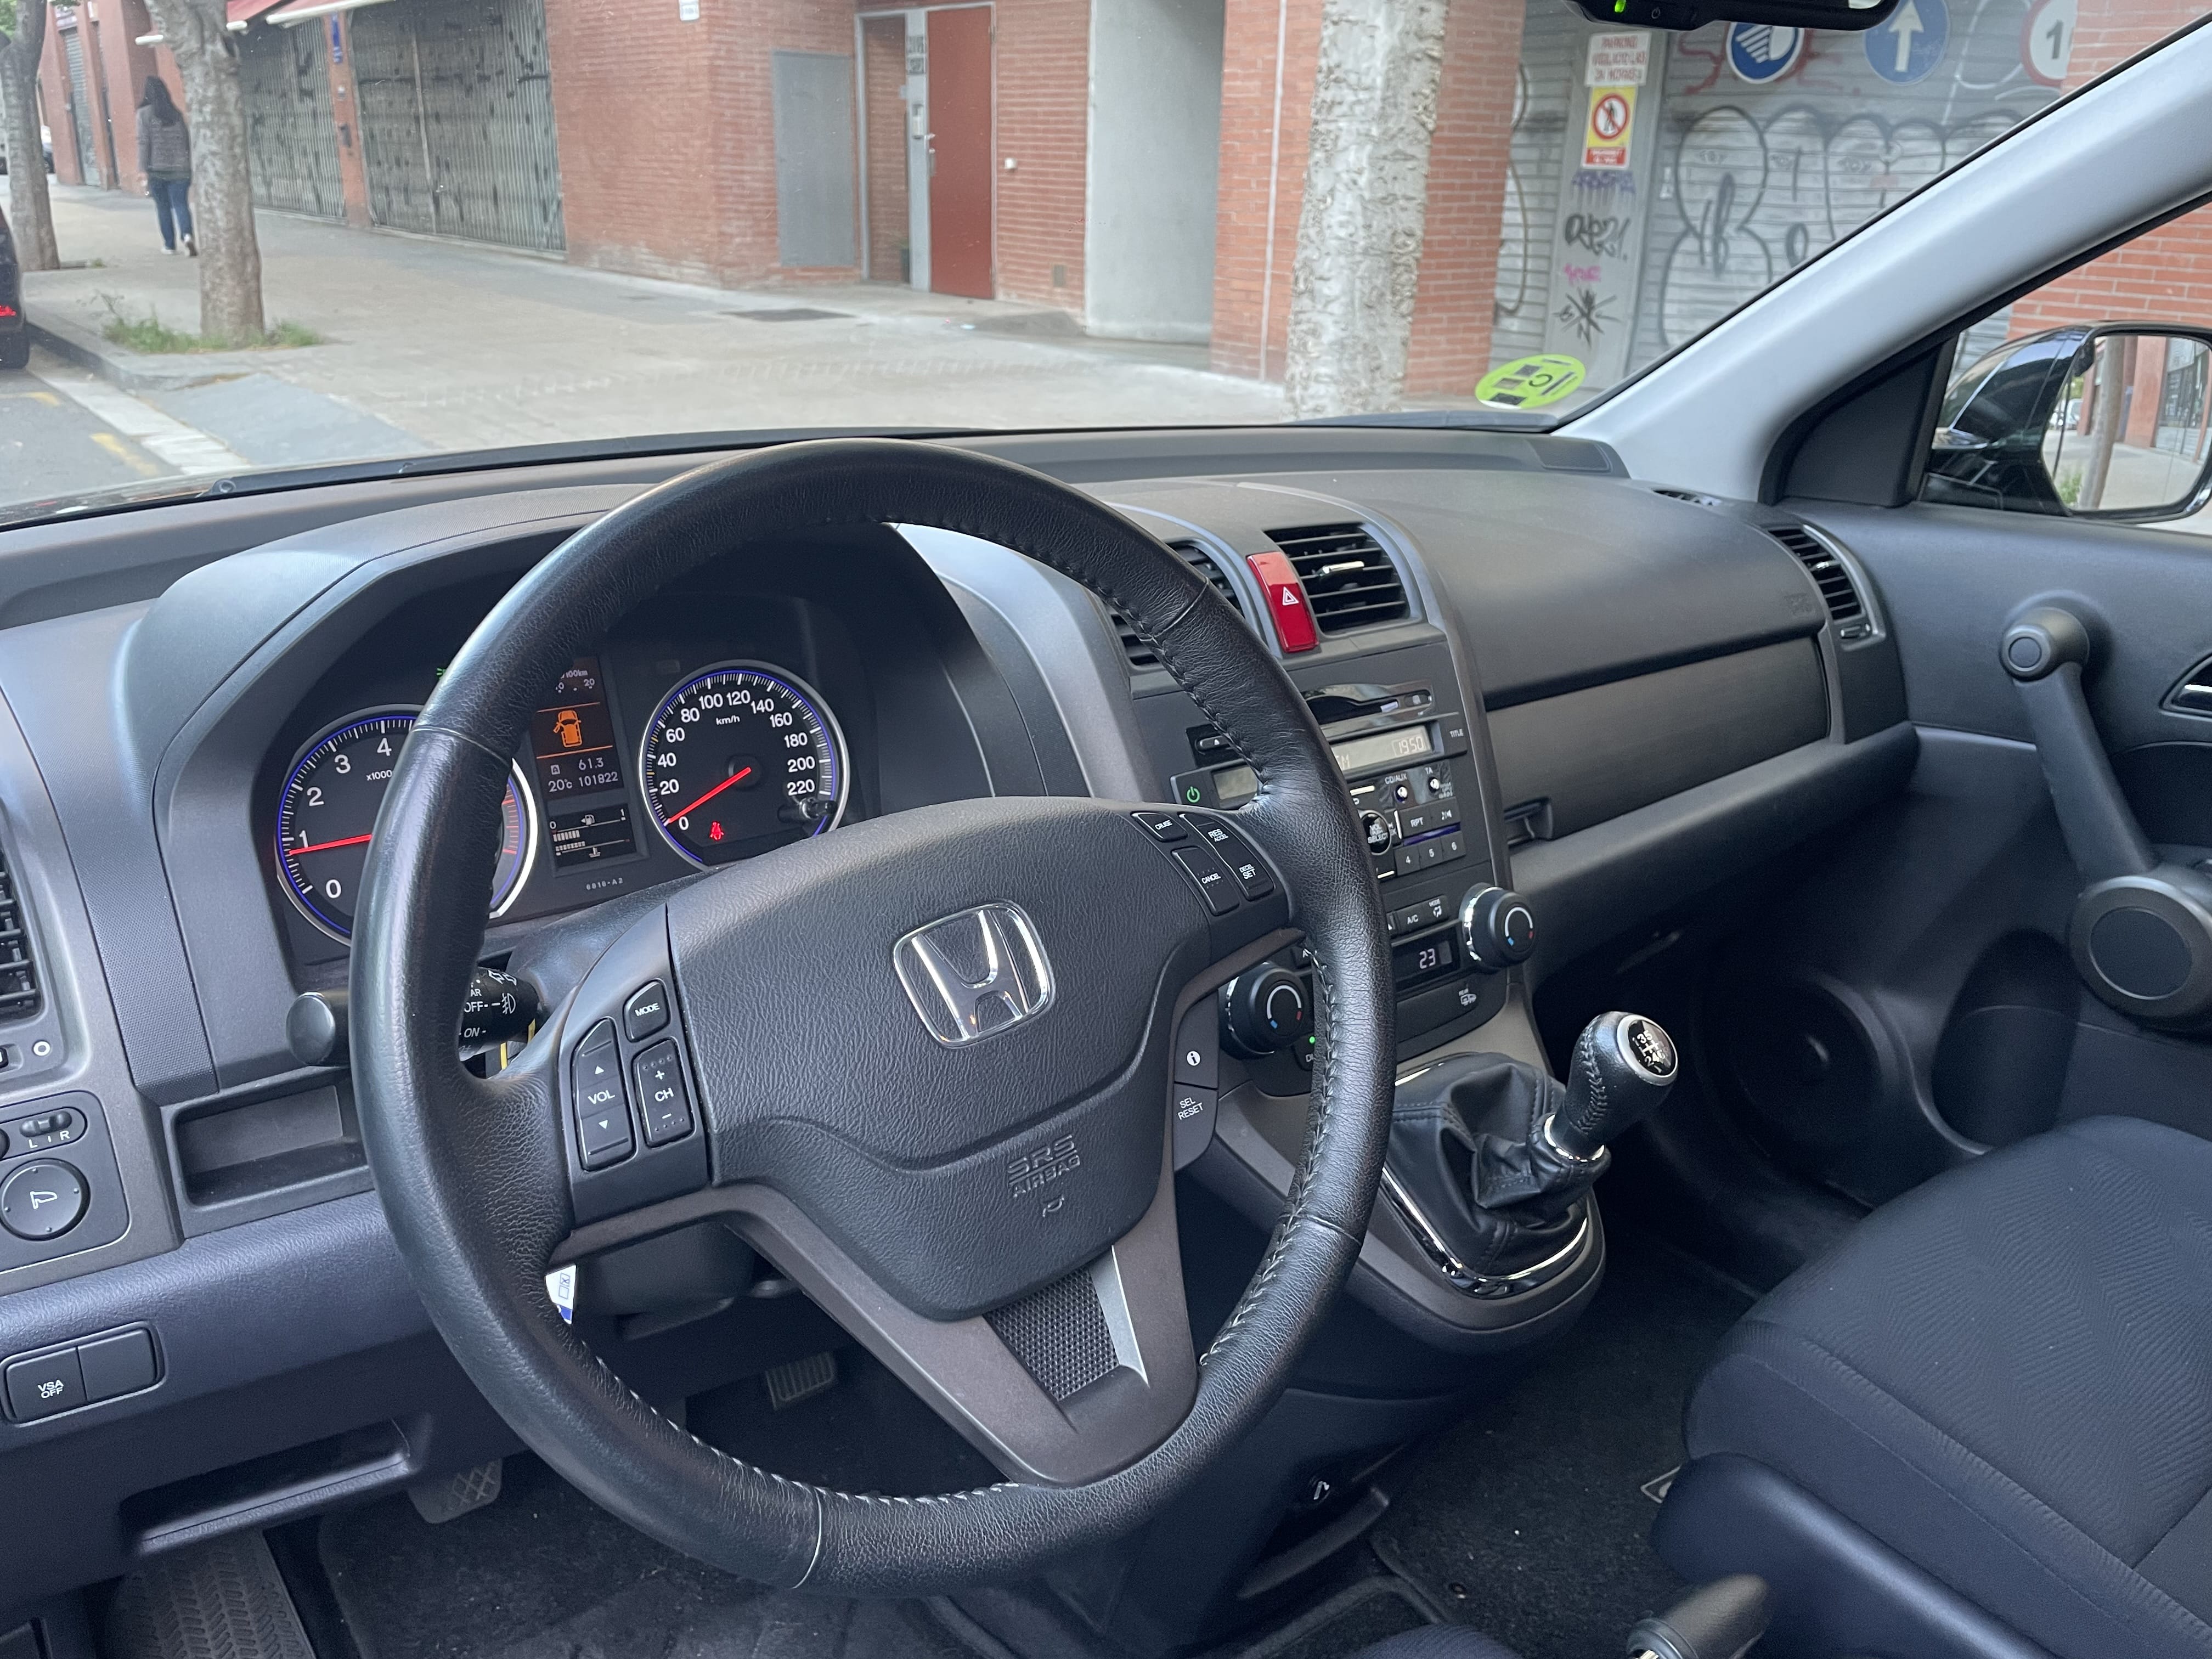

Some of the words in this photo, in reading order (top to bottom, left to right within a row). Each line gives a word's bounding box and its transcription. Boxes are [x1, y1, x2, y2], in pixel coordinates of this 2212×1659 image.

[2046, 19, 2073, 59] 1
[583, 678, 595, 687] 20
[699, 693, 724, 710] 100
[726, 690, 751, 706] 120
[751, 698, 775, 714] 140
[681, 707, 700, 723] 80
[716, 714, 740, 725] km/h
[769, 712, 793, 727] 160
[665, 727, 685, 743] 60
[784, 732, 808, 748] 180
[1449, 729, 1464, 737] TITLE
[377, 738, 392, 756] 4
[334, 754, 351, 774] 3
[578, 757, 604, 771] 61.3
[657, 752, 677, 768] 40
[787, 755, 815, 773] 200
[366, 769, 392, 781] x1000
[579, 771, 618, 787] 101822
[1385, 774, 1407, 785] CD/AUX
[659, 779, 680, 795] 20
[787, 778, 815, 796] 220
[307, 787, 325, 806] 2
[550, 821, 557, 830] 0
[678, 816, 689, 831] 0
[1155, 820, 1173, 830] CRUISE
[1410, 817, 1424, 827] RPT
[299, 830, 308, 848] 1
[1208, 828, 1223, 839] RES
[1214, 834, 1229, 842] ACCEL
[1406, 856, 1411, 864] 4
[1429, 849, 1435, 857] 5
[1452, 842, 1457, 850] 6
[1239, 864, 1254, 873] DECEL
[1243, 870, 1256, 879] SET
[1201, 873, 1221, 884] CANCEL
[326, 879, 341, 899] 0
[1407, 915, 1419, 924] A/C
[1419, 948, 1436, 969] 23
[635, 1003, 661, 1017] MODE
[464, 1028, 480, 1038] ON
[1637, 1033, 1646, 1043] 3
[1643, 1030, 1652, 1041] 5
[1645, 1056, 1654, 1066] 2
[1652, 1052, 1660, 1062] 4
[588, 1090, 616, 1104] VOL
[654, 1087, 674, 1102] CH
[1180, 1097, 1196, 1109] SEL
[1177, 1102, 1204, 1120] RESET
[29, 1139, 38, 1148] L
[60, 1130, 70, 1141] R
[1008, 1135, 1074, 1180] SRS
[1013, 1155, 1080, 1197] AIRBAG
[37, 1379, 64, 1392] VSA
[41, 1386, 63, 1399] OFF
